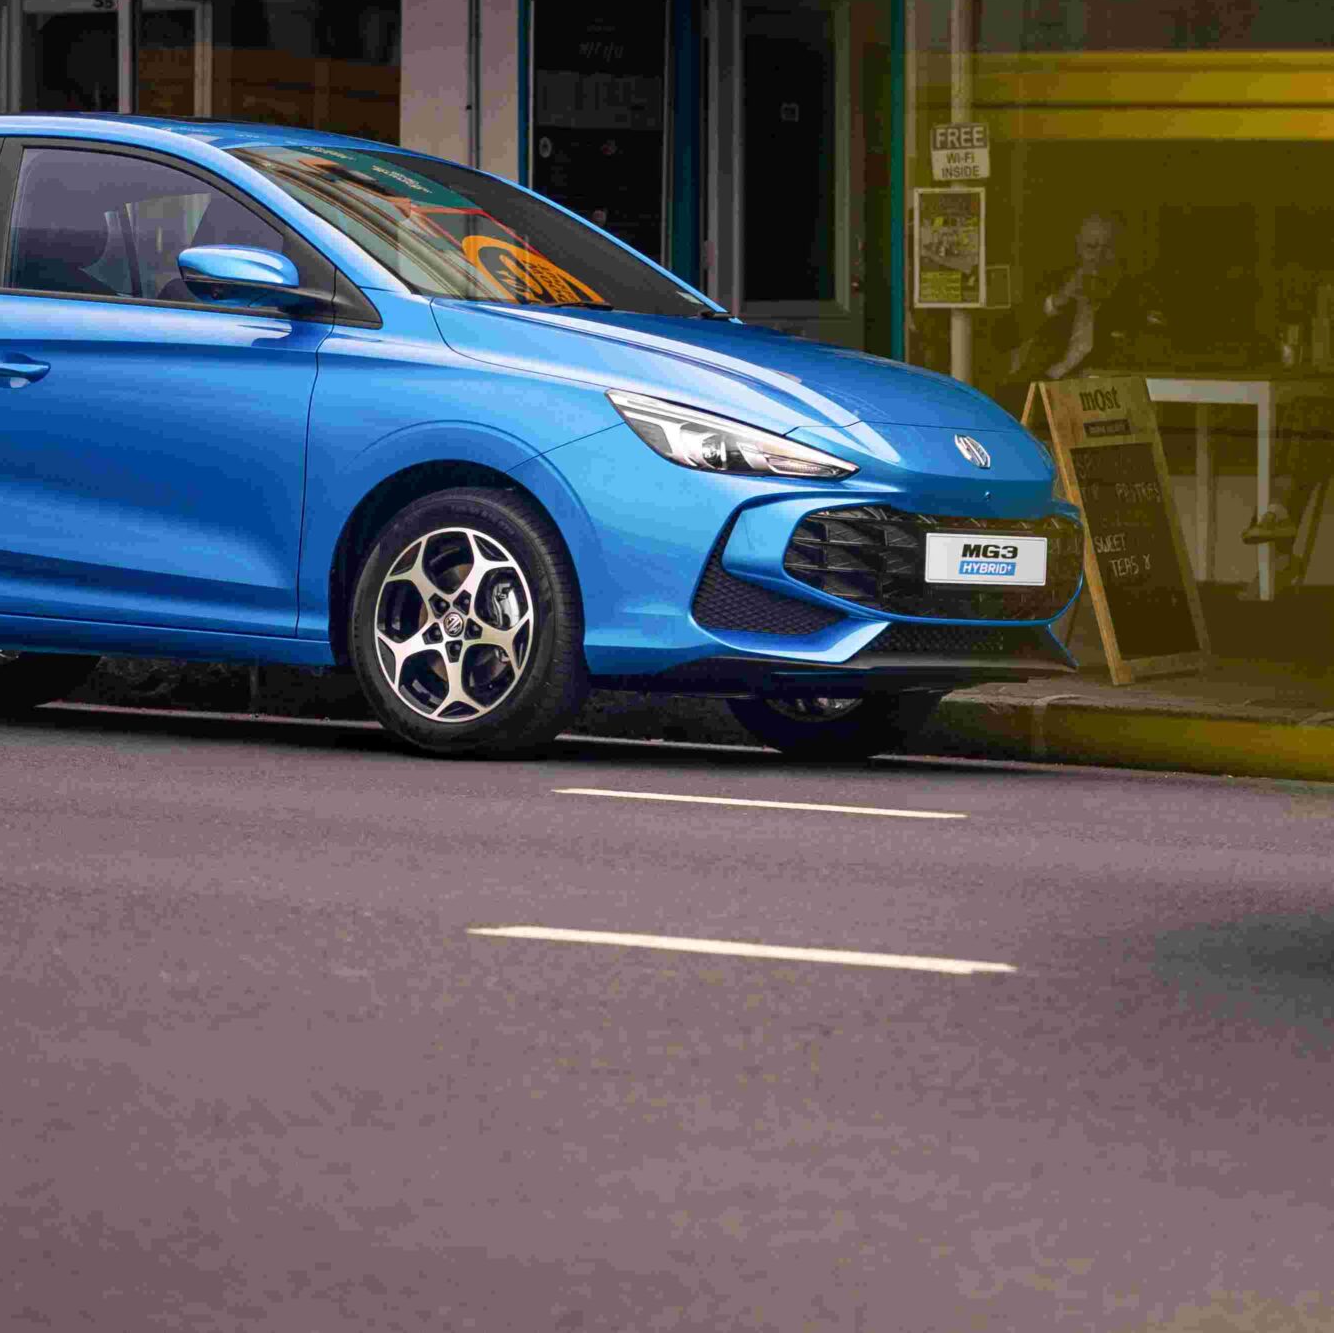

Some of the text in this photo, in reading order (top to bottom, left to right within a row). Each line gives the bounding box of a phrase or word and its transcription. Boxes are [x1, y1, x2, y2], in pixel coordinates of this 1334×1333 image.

[935, 126, 985, 148] FREE
[941, 165, 980, 179] INSIDE
[961, 543, 1019, 560] MG3
